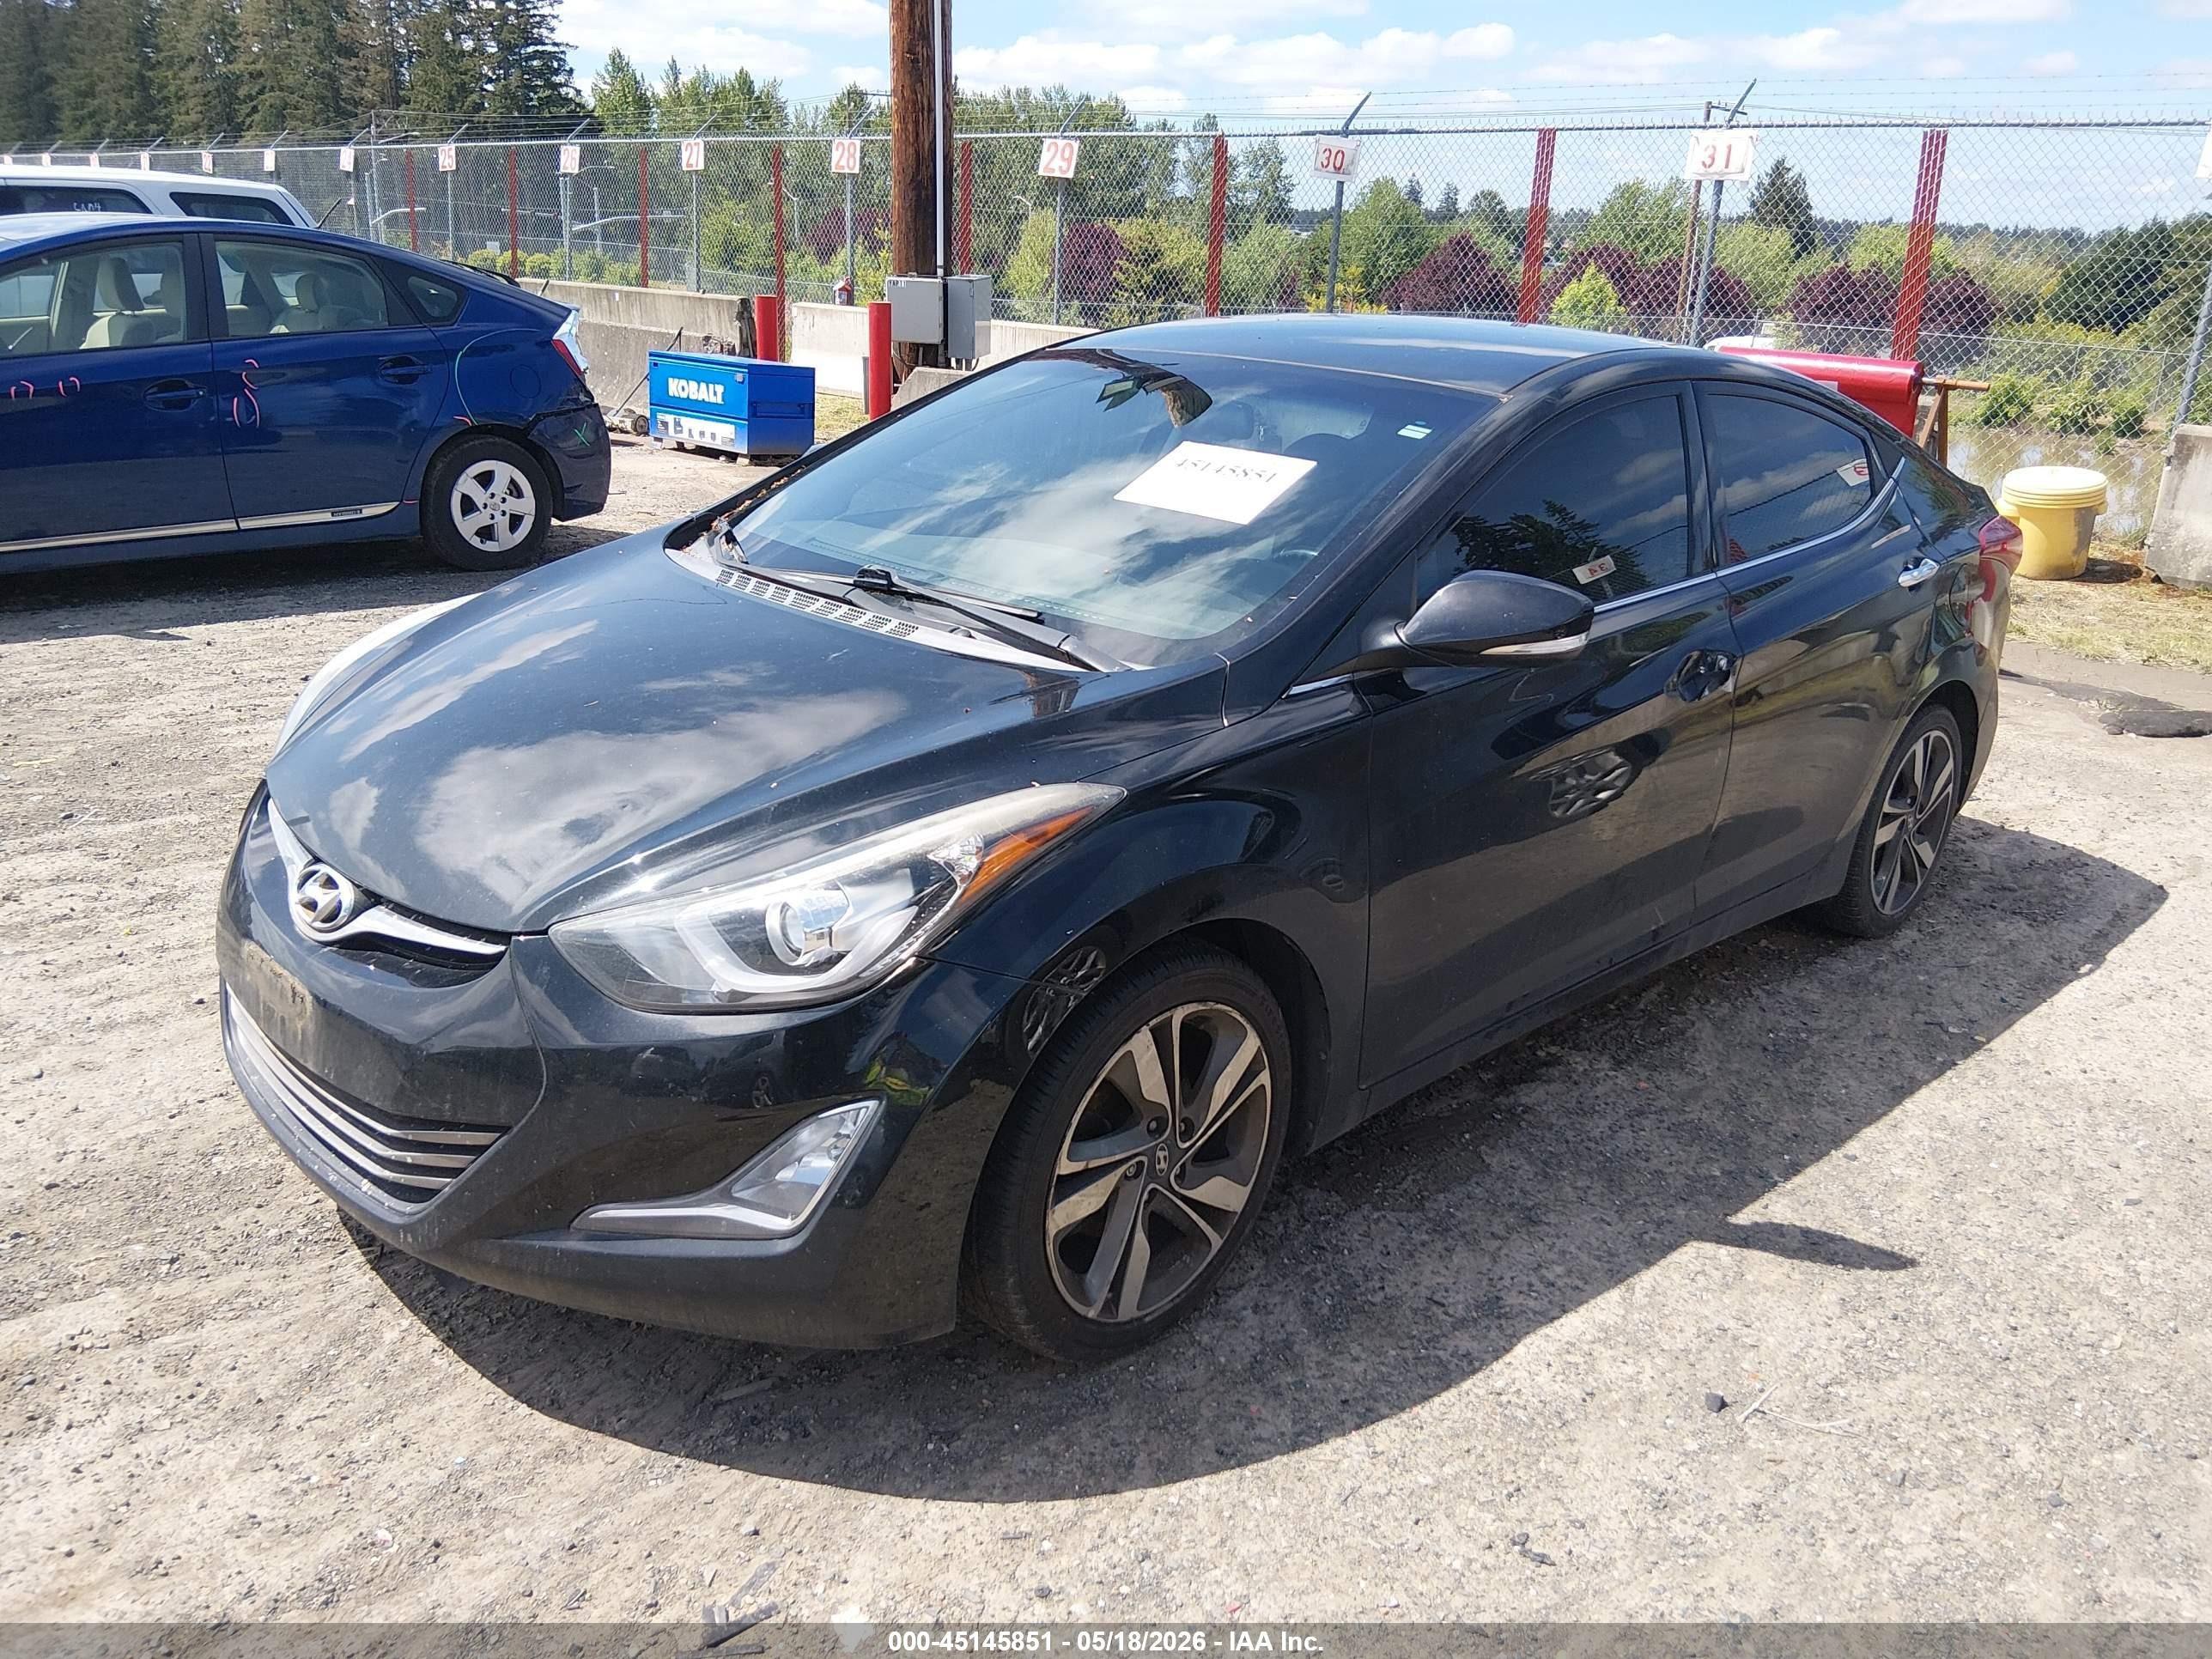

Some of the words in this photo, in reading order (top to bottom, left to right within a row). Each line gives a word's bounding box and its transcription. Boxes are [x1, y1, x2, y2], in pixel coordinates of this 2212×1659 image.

[440, 147, 454, 169] 25
[562, 148, 579, 173] 26
[684, 142, 701, 168] 27
[835, 141, 857, 171] 28
[1042, 142, 1073, 173] 29
[1321, 148, 1346, 172] 30
[1701, 144, 1732, 169] 31
[667, 377, 725, 404] KOBALT
